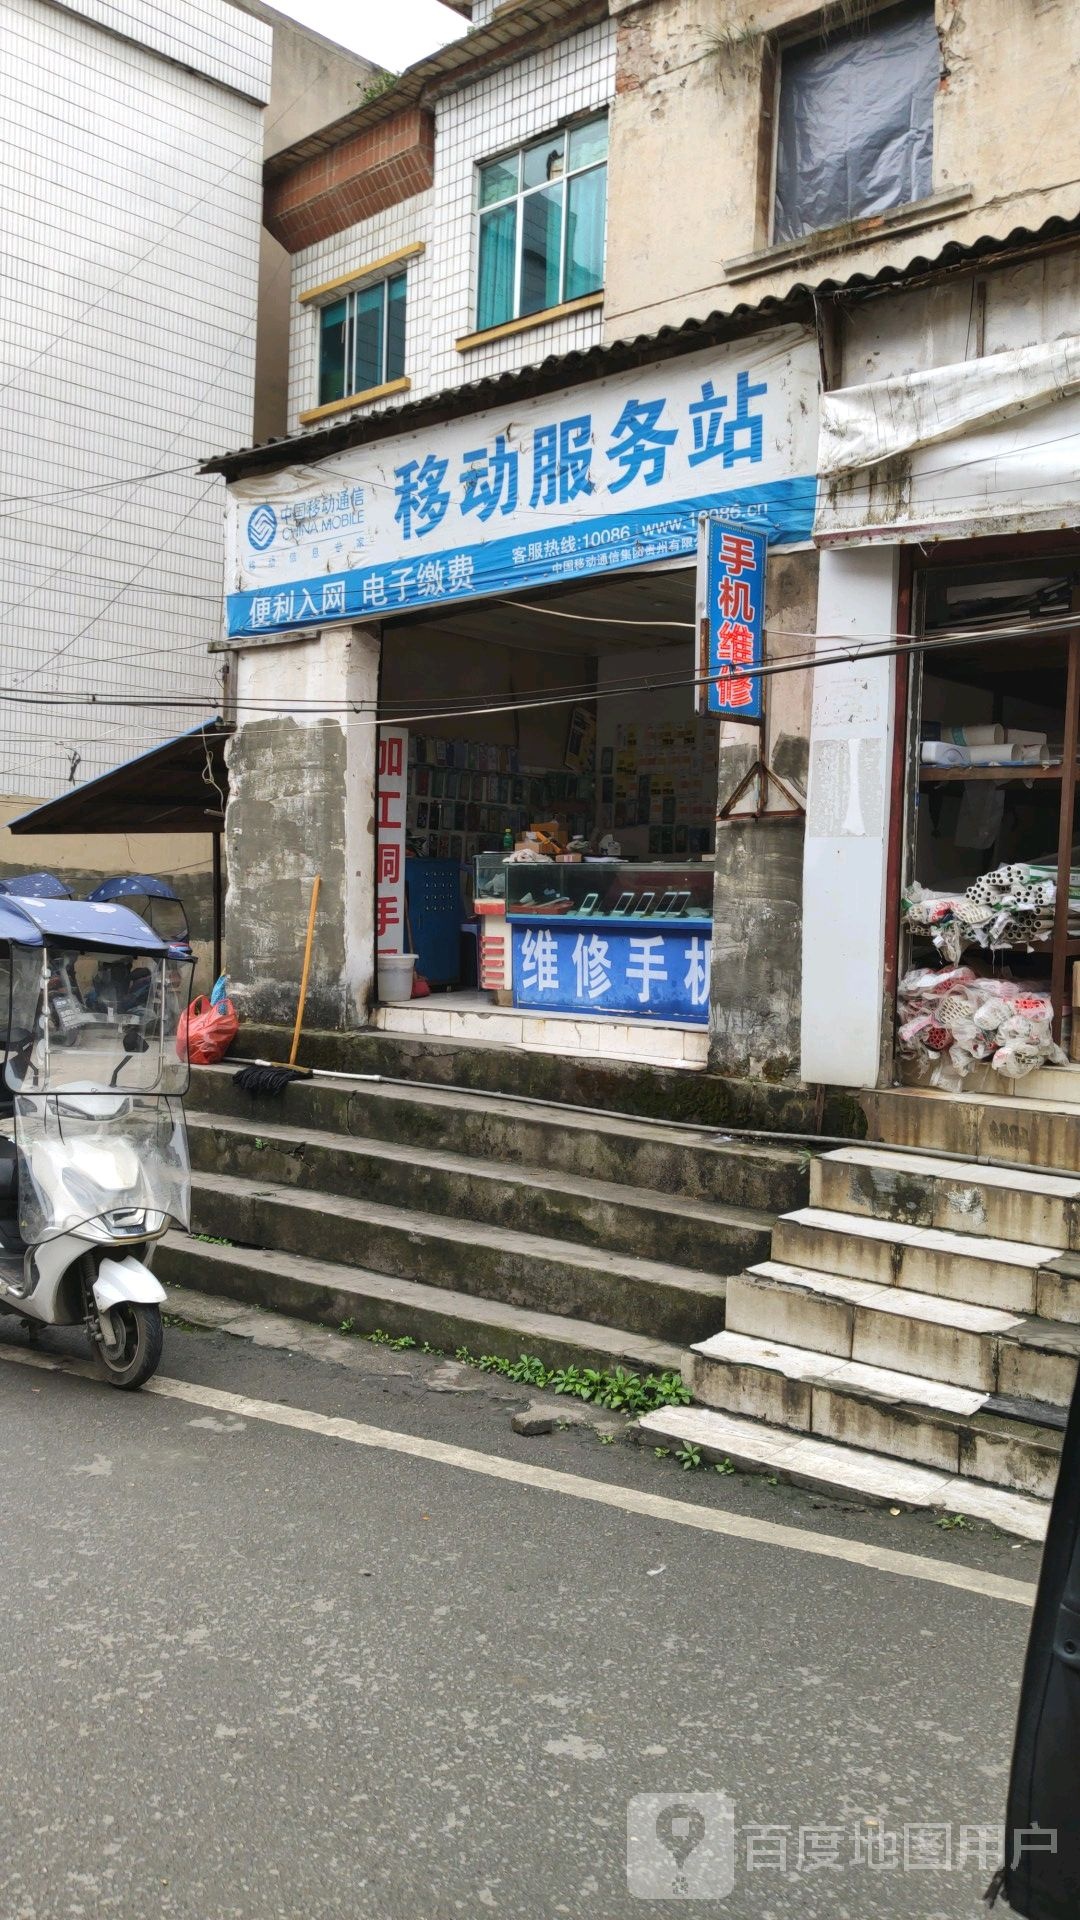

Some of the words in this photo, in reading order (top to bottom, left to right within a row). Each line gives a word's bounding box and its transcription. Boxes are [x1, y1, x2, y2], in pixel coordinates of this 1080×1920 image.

[393, 371, 768, 541] 移动服务站
[280, 487, 365, 525] 中国移动通信
[282, 522, 319, 541] CHINA
[321, 509, 365, 534] MOBILE
[511, 525, 631, 565] 客服热线:10086
[551, 537, 698, 574] 中国移动通信集团贵州有限
[249, 580, 346, 628] 便利入网
[362, 553, 477, 607] 电子缴费
[717, 533, 756, 707] 手机维修
